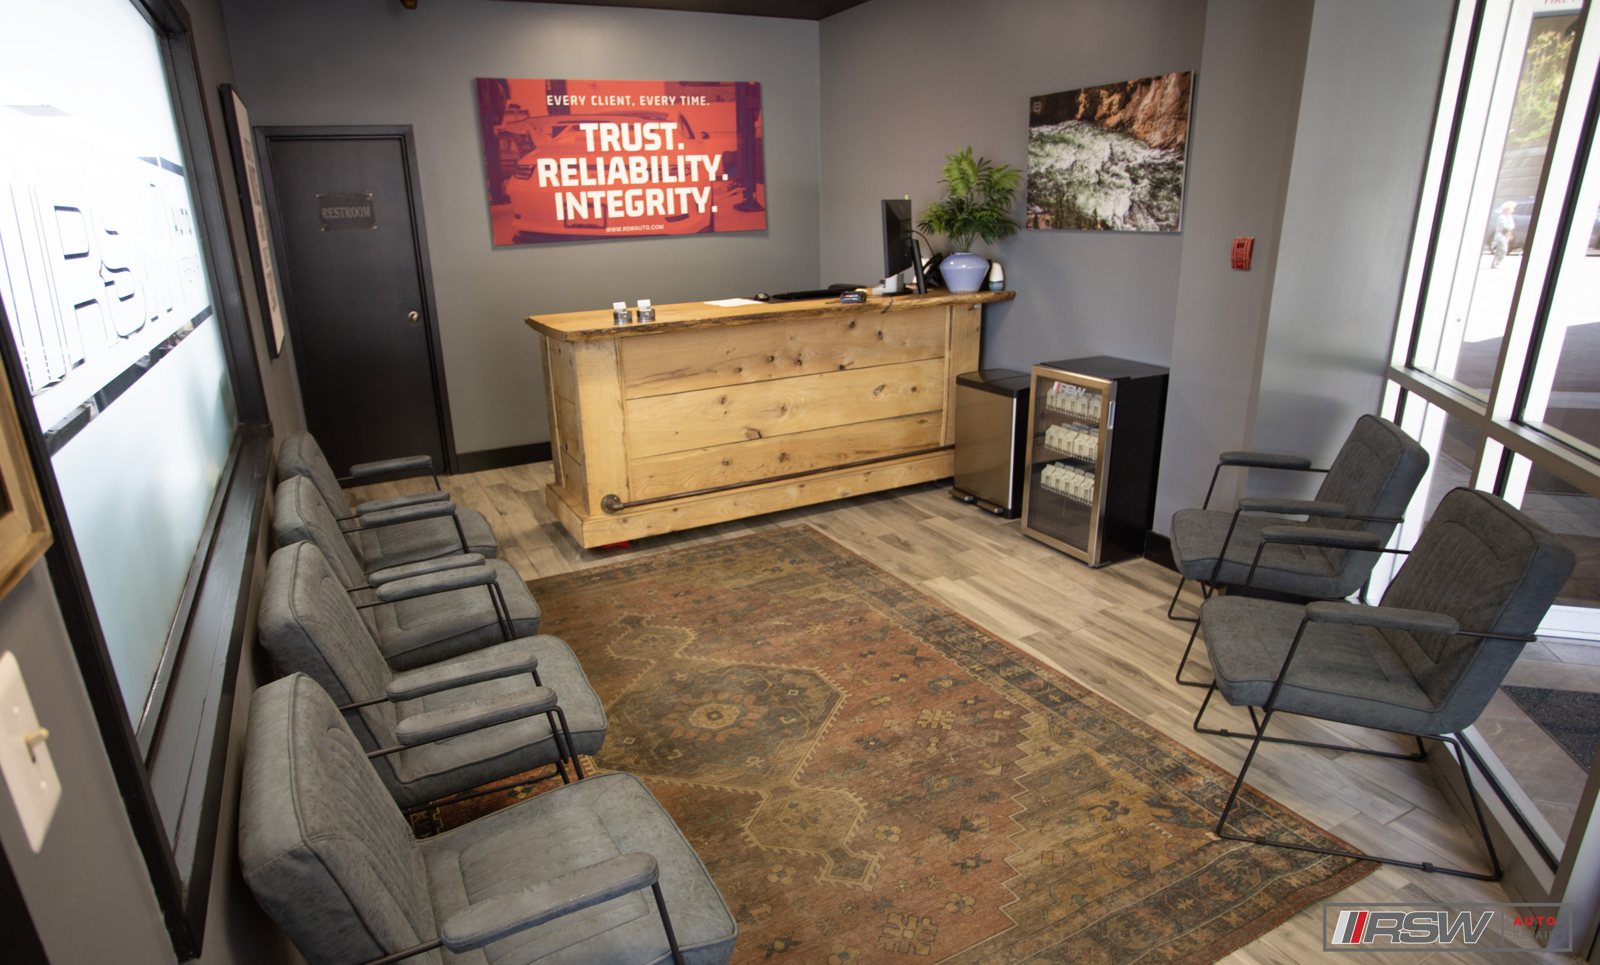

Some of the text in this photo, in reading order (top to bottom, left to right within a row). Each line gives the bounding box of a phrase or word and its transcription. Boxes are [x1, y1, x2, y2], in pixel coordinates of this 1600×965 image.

[546, 95, 711, 107] EVERY CLIENT, EVERY TIME.
[579, 122, 685, 152] TRUST.
[537, 154, 729, 188] RELIABILITY.
[320, 207, 372, 219] RESTROOM
[555, 186, 718, 221] INTEGRITY.
